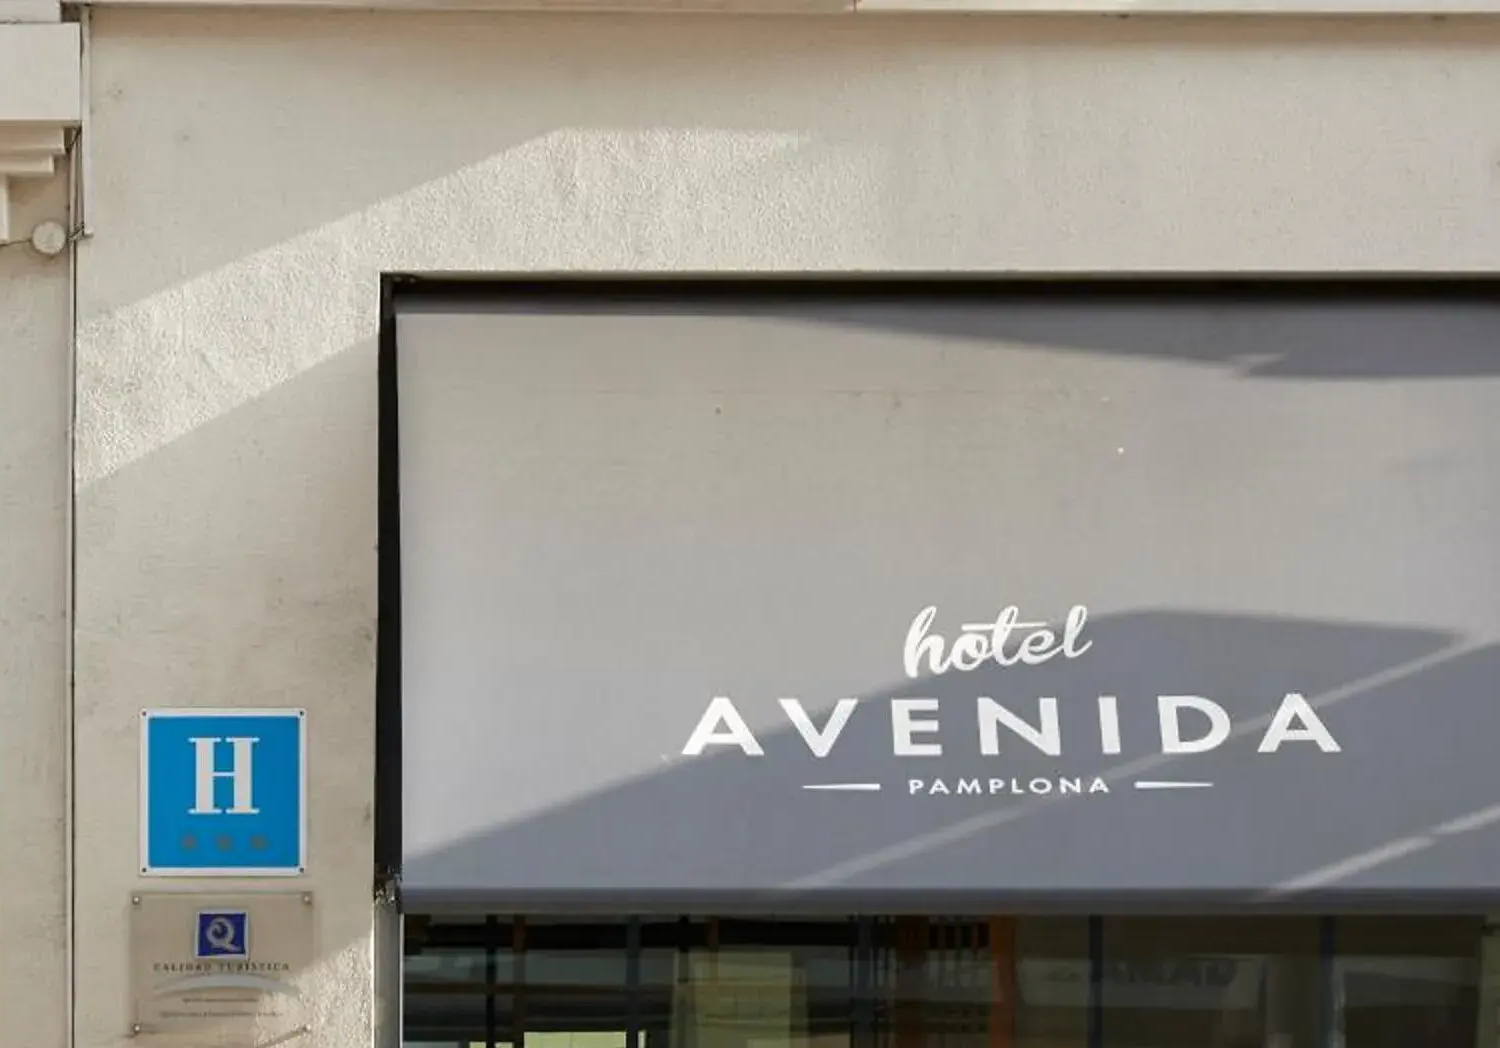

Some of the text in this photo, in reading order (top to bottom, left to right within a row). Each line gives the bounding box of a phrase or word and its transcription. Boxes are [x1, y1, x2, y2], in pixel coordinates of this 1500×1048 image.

[903, 604, 1093, 678] hotel
[681, 693, 1341, 757] AVENIDA
[188, 737, 260, 814] H
[908, 777, 1110, 795] PAMPLONA
